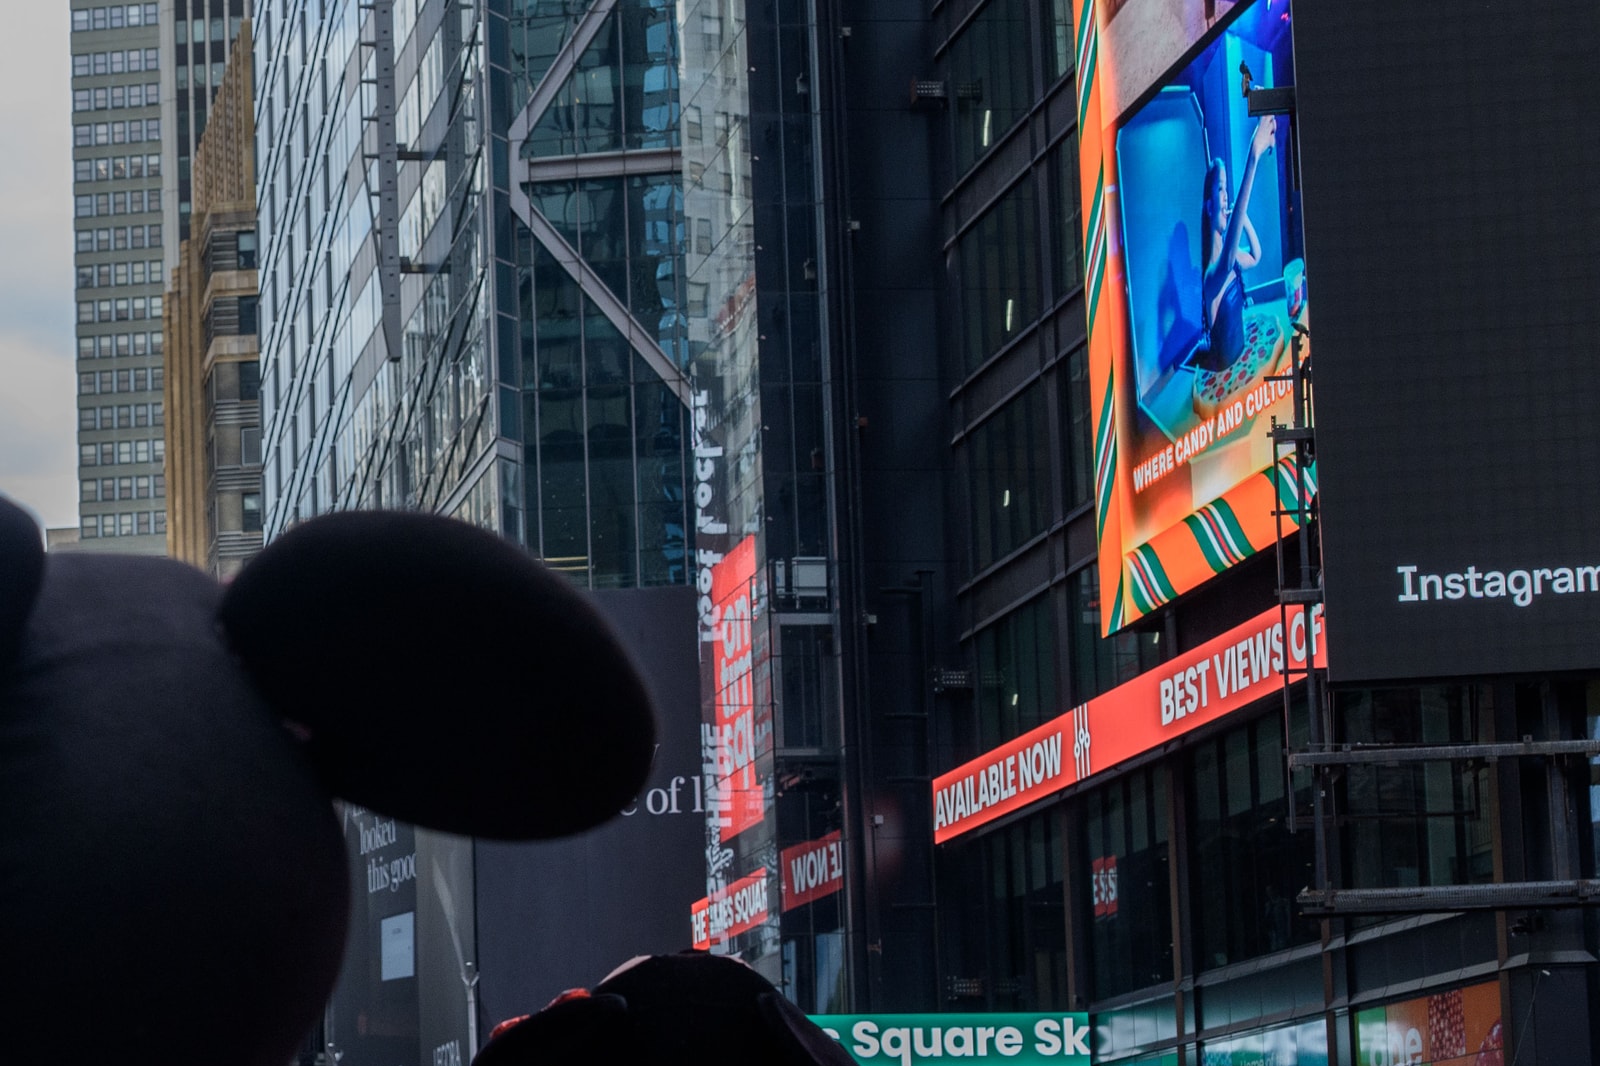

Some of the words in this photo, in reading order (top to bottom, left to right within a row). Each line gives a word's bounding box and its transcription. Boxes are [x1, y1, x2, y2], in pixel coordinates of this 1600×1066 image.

[1133, 446, 1174, 493] WHERE
[1175, 420, 1215, 465] CANDY
[1217, 402, 1243, 438] AND
[1397, 565, 1600, 608] Instagram
[1159, 655, 1211, 727] BEST
[1213, 622, 1285, 700] VIEWS
[646, 776, 685, 815] of
[934, 760, 1017, 832] AVAILABLE
[1018, 732, 1062, 793] NOW
[359, 816, 397, 856] looked
[367, 856, 389, 894] this
